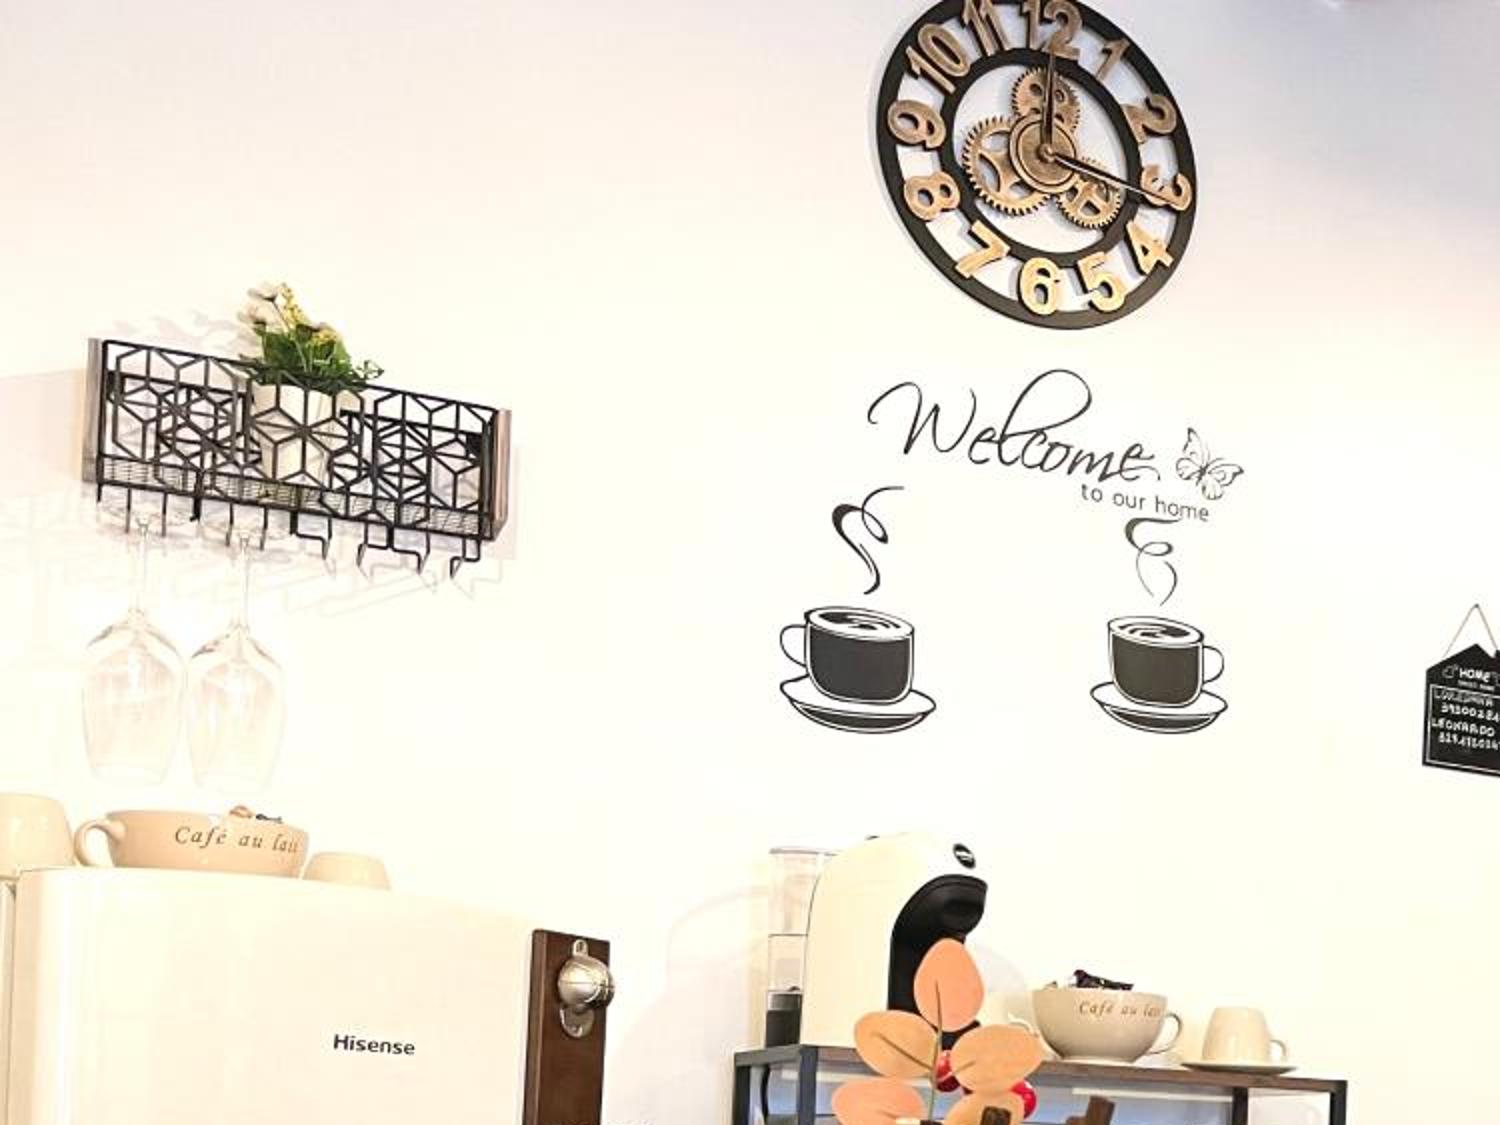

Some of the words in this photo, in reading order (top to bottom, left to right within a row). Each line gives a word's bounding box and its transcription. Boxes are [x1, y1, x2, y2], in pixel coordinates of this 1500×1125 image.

[962, 0, 1010, 57] 11
[1022, 0, 1082, 61] 12
[905, 23, 971, 95] 10
[1095, 38, 1130, 80] 1
[887, 99, 946, 149] 9
[1120, 93, 1177, 144] 2
[904, 171, 961, 222] 8
[955, 220, 1011, 279] 7
[1125, 221, 1174, 275] 4
[1018, 256, 1060, 316] 6
[1077, 251, 1128, 312] 5
[867, 369, 1161, 483] Welcome
[1081, 483, 1104, 503] to
[1112, 491, 1147, 512] our
[1154, 495, 1211, 523] home
[174, 825, 228, 849] Café
[238, 835, 263, 849] au
[333, 1033, 416, 1055] Hisense
